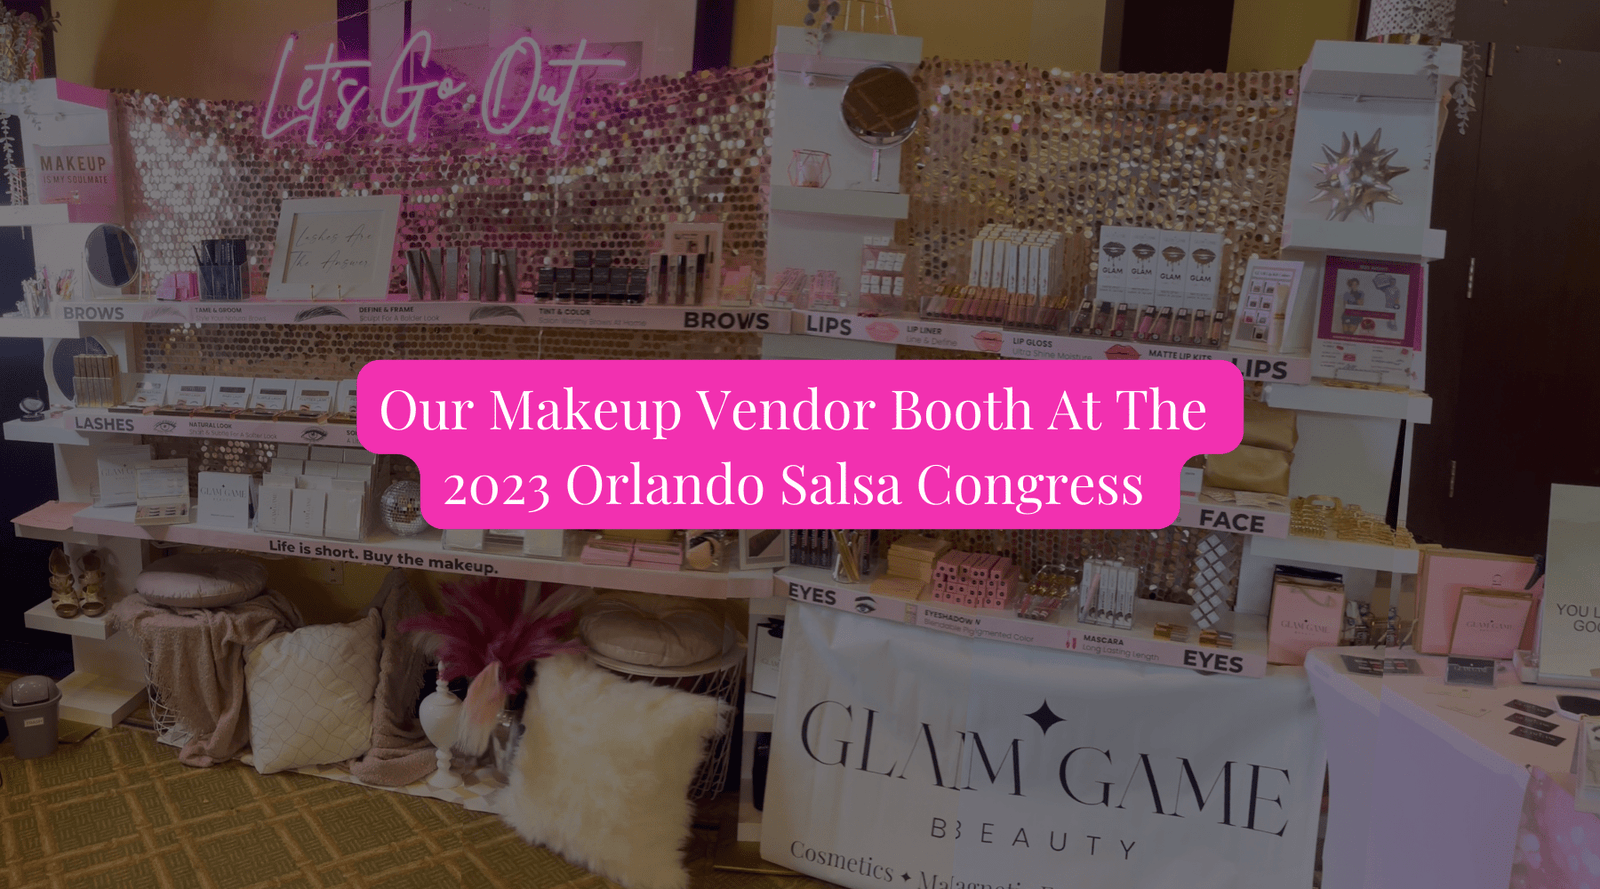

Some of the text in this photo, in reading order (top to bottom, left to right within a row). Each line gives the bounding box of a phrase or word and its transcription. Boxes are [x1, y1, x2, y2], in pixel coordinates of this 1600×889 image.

[261, 29, 627, 147] Let's Go Out
[39, 155, 106, 171] MAKEUP
[43, 175, 108, 184] IS MY SOULMATE
[295, 223, 372, 248] Lashes Are
[289, 249, 369, 274] The Answer
[63, 306, 125, 320] BROWS
[564, 308, 591, 316] COLOR
[684, 311, 769, 330] BROWS
[807, 315, 852, 336] LIPS
[907, 325, 942, 335] LIP LINER
[1013, 337, 1053, 348] LIP GLOSS
[1012, 348, 1032, 357] Ultra
[1033, 349, 1056, 359] Shine
[1149, 349, 1178, 360] MATTE
[1179, 352, 1191, 360] LIP
[75, 416, 135, 432] LASHES
[1200, 509, 1265, 533] FACE
[269, 540, 499, 576] Life is short. Buy the makeup.
[788, 581, 837, 606] EYES
[1556, 603, 1589, 618] YOU
[1013, 633, 1035, 642] Color
[1083, 634, 1124, 646] MASCARA
[1082, 643, 1160, 662] Long Lasting Length
[1183, 649, 1244, 674] EYES
[1059, 746, 1291, 838] GAME
[790, 840, 894, 883] Cosmetics
